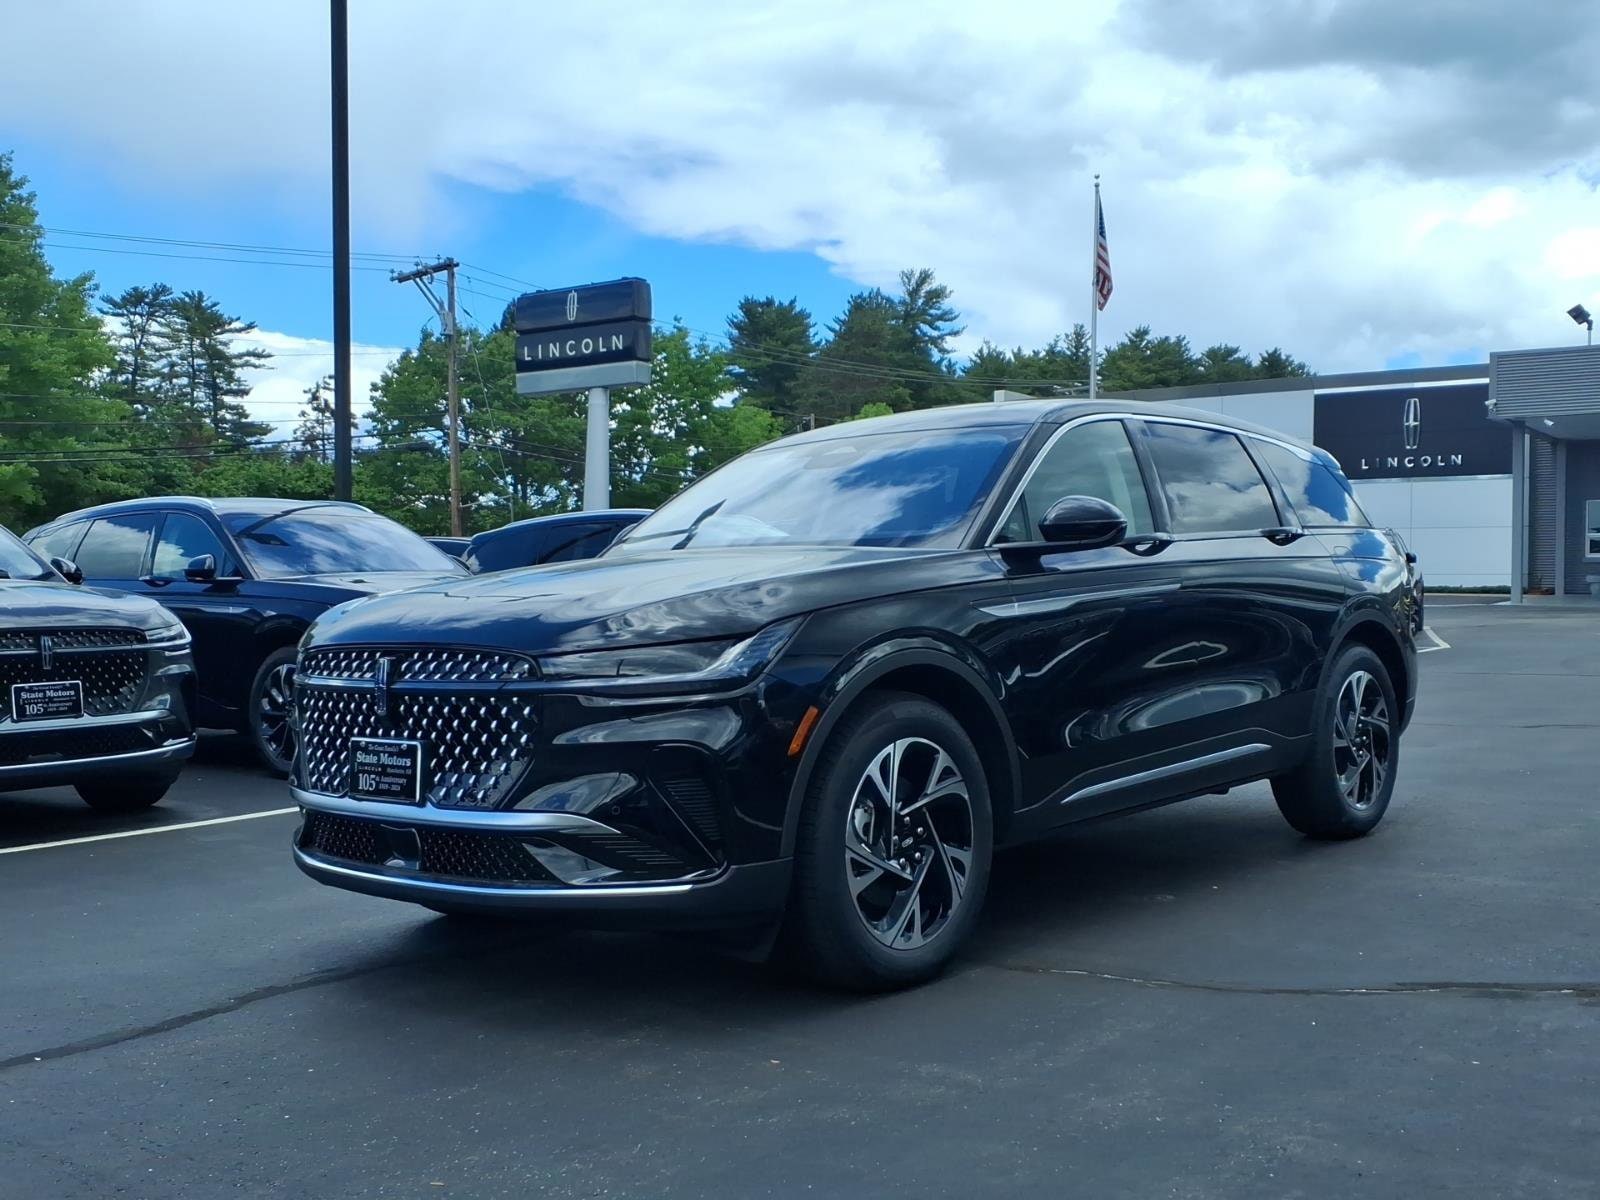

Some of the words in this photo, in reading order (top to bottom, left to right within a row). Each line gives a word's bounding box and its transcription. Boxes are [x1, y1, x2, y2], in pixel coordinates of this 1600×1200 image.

[524, 334, 623, 361] LINCOLN
[1361, 454, 1463, 469] LINCOLN
[20, 691, 44, 699] State
[356, 751, 378, 763] State
[379, 753, 411, 766] Motors
